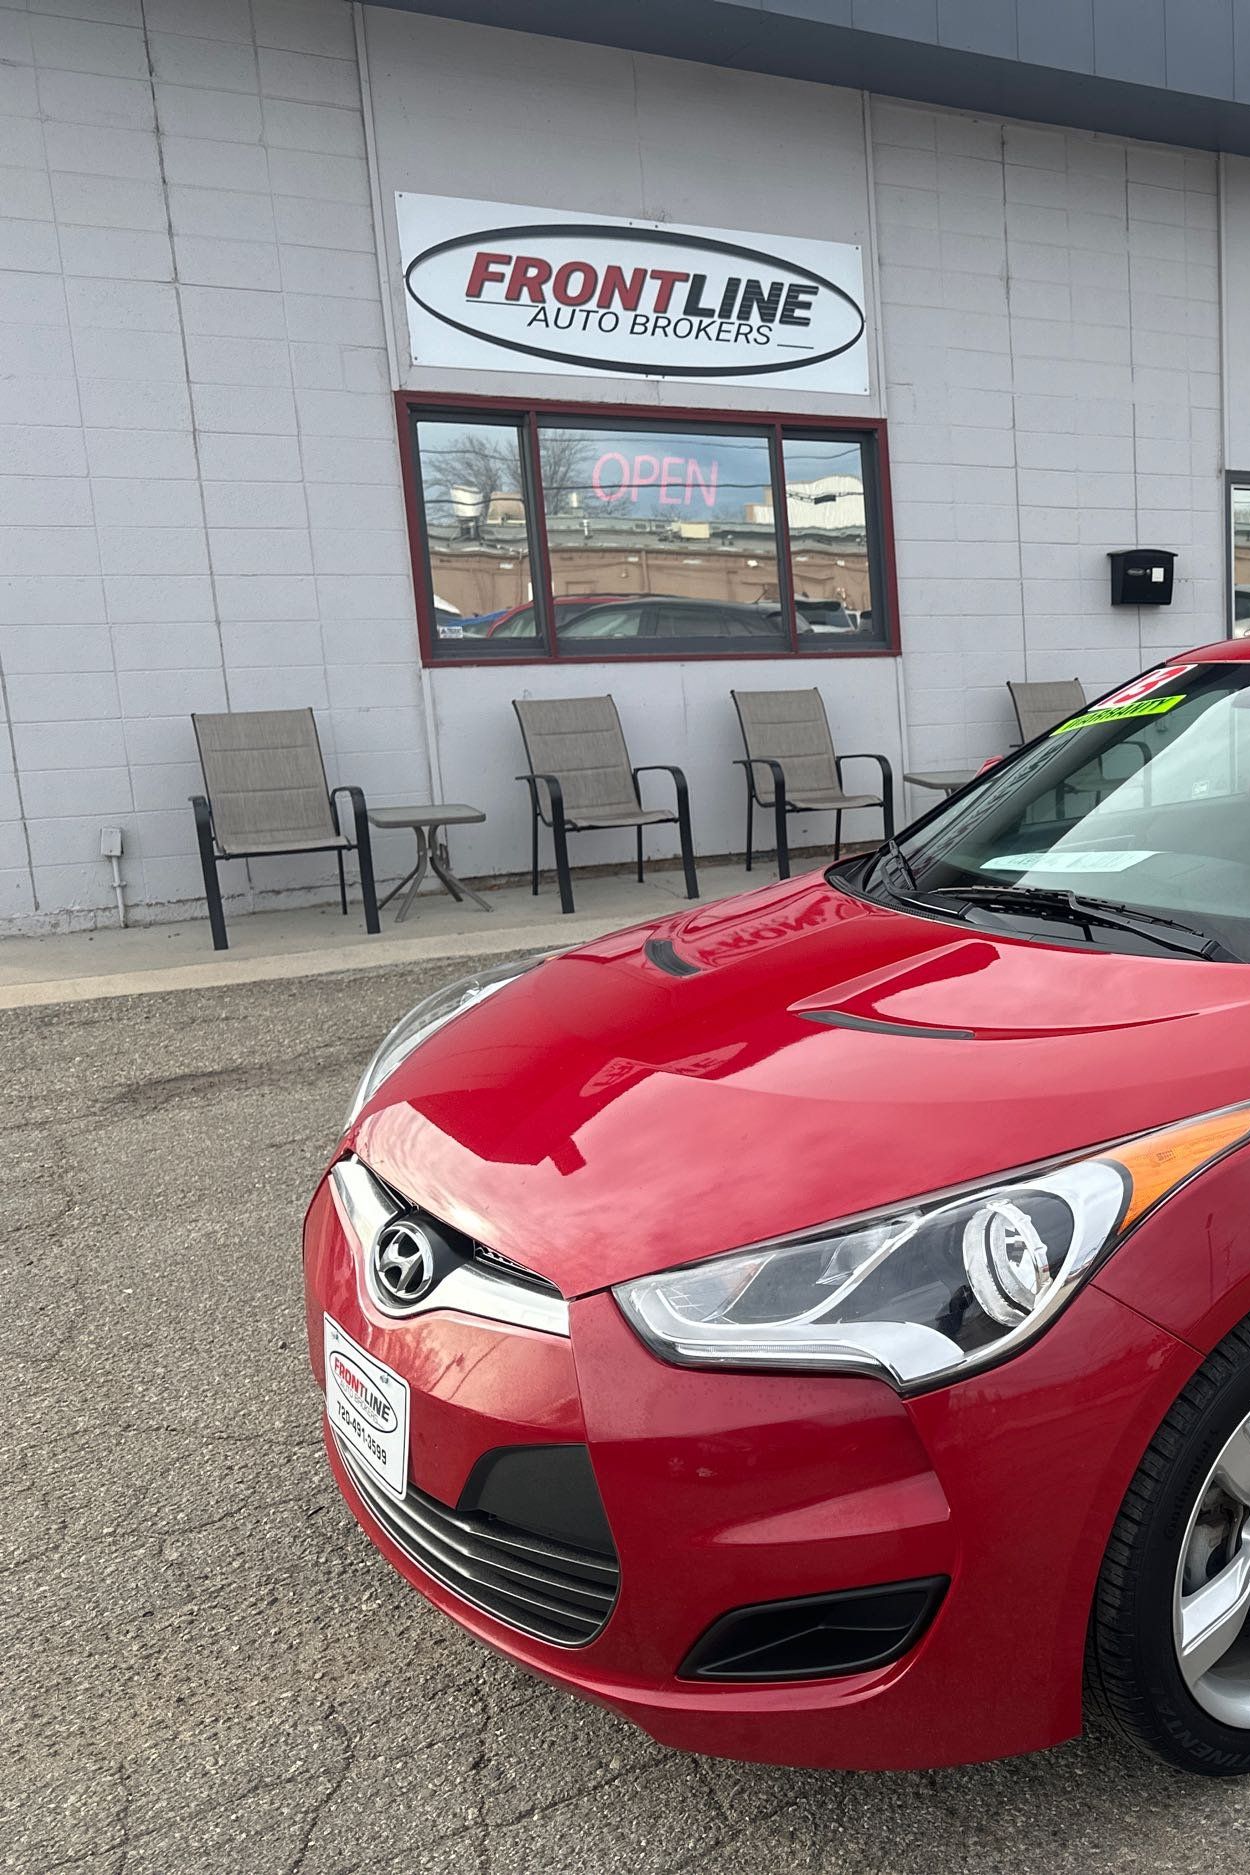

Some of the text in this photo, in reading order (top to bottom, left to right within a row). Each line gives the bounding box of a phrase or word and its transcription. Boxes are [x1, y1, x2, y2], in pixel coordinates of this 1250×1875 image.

[465, 251, 820, 328] FRONTLINE
[526, 305, 774, 347] AUTO BROKERS
[591, 451, 719, 508] OPEN
[334, 1356, 391, 1422] FRONTLINE
[336, 1400, 387, 1465] 720-491-3599
